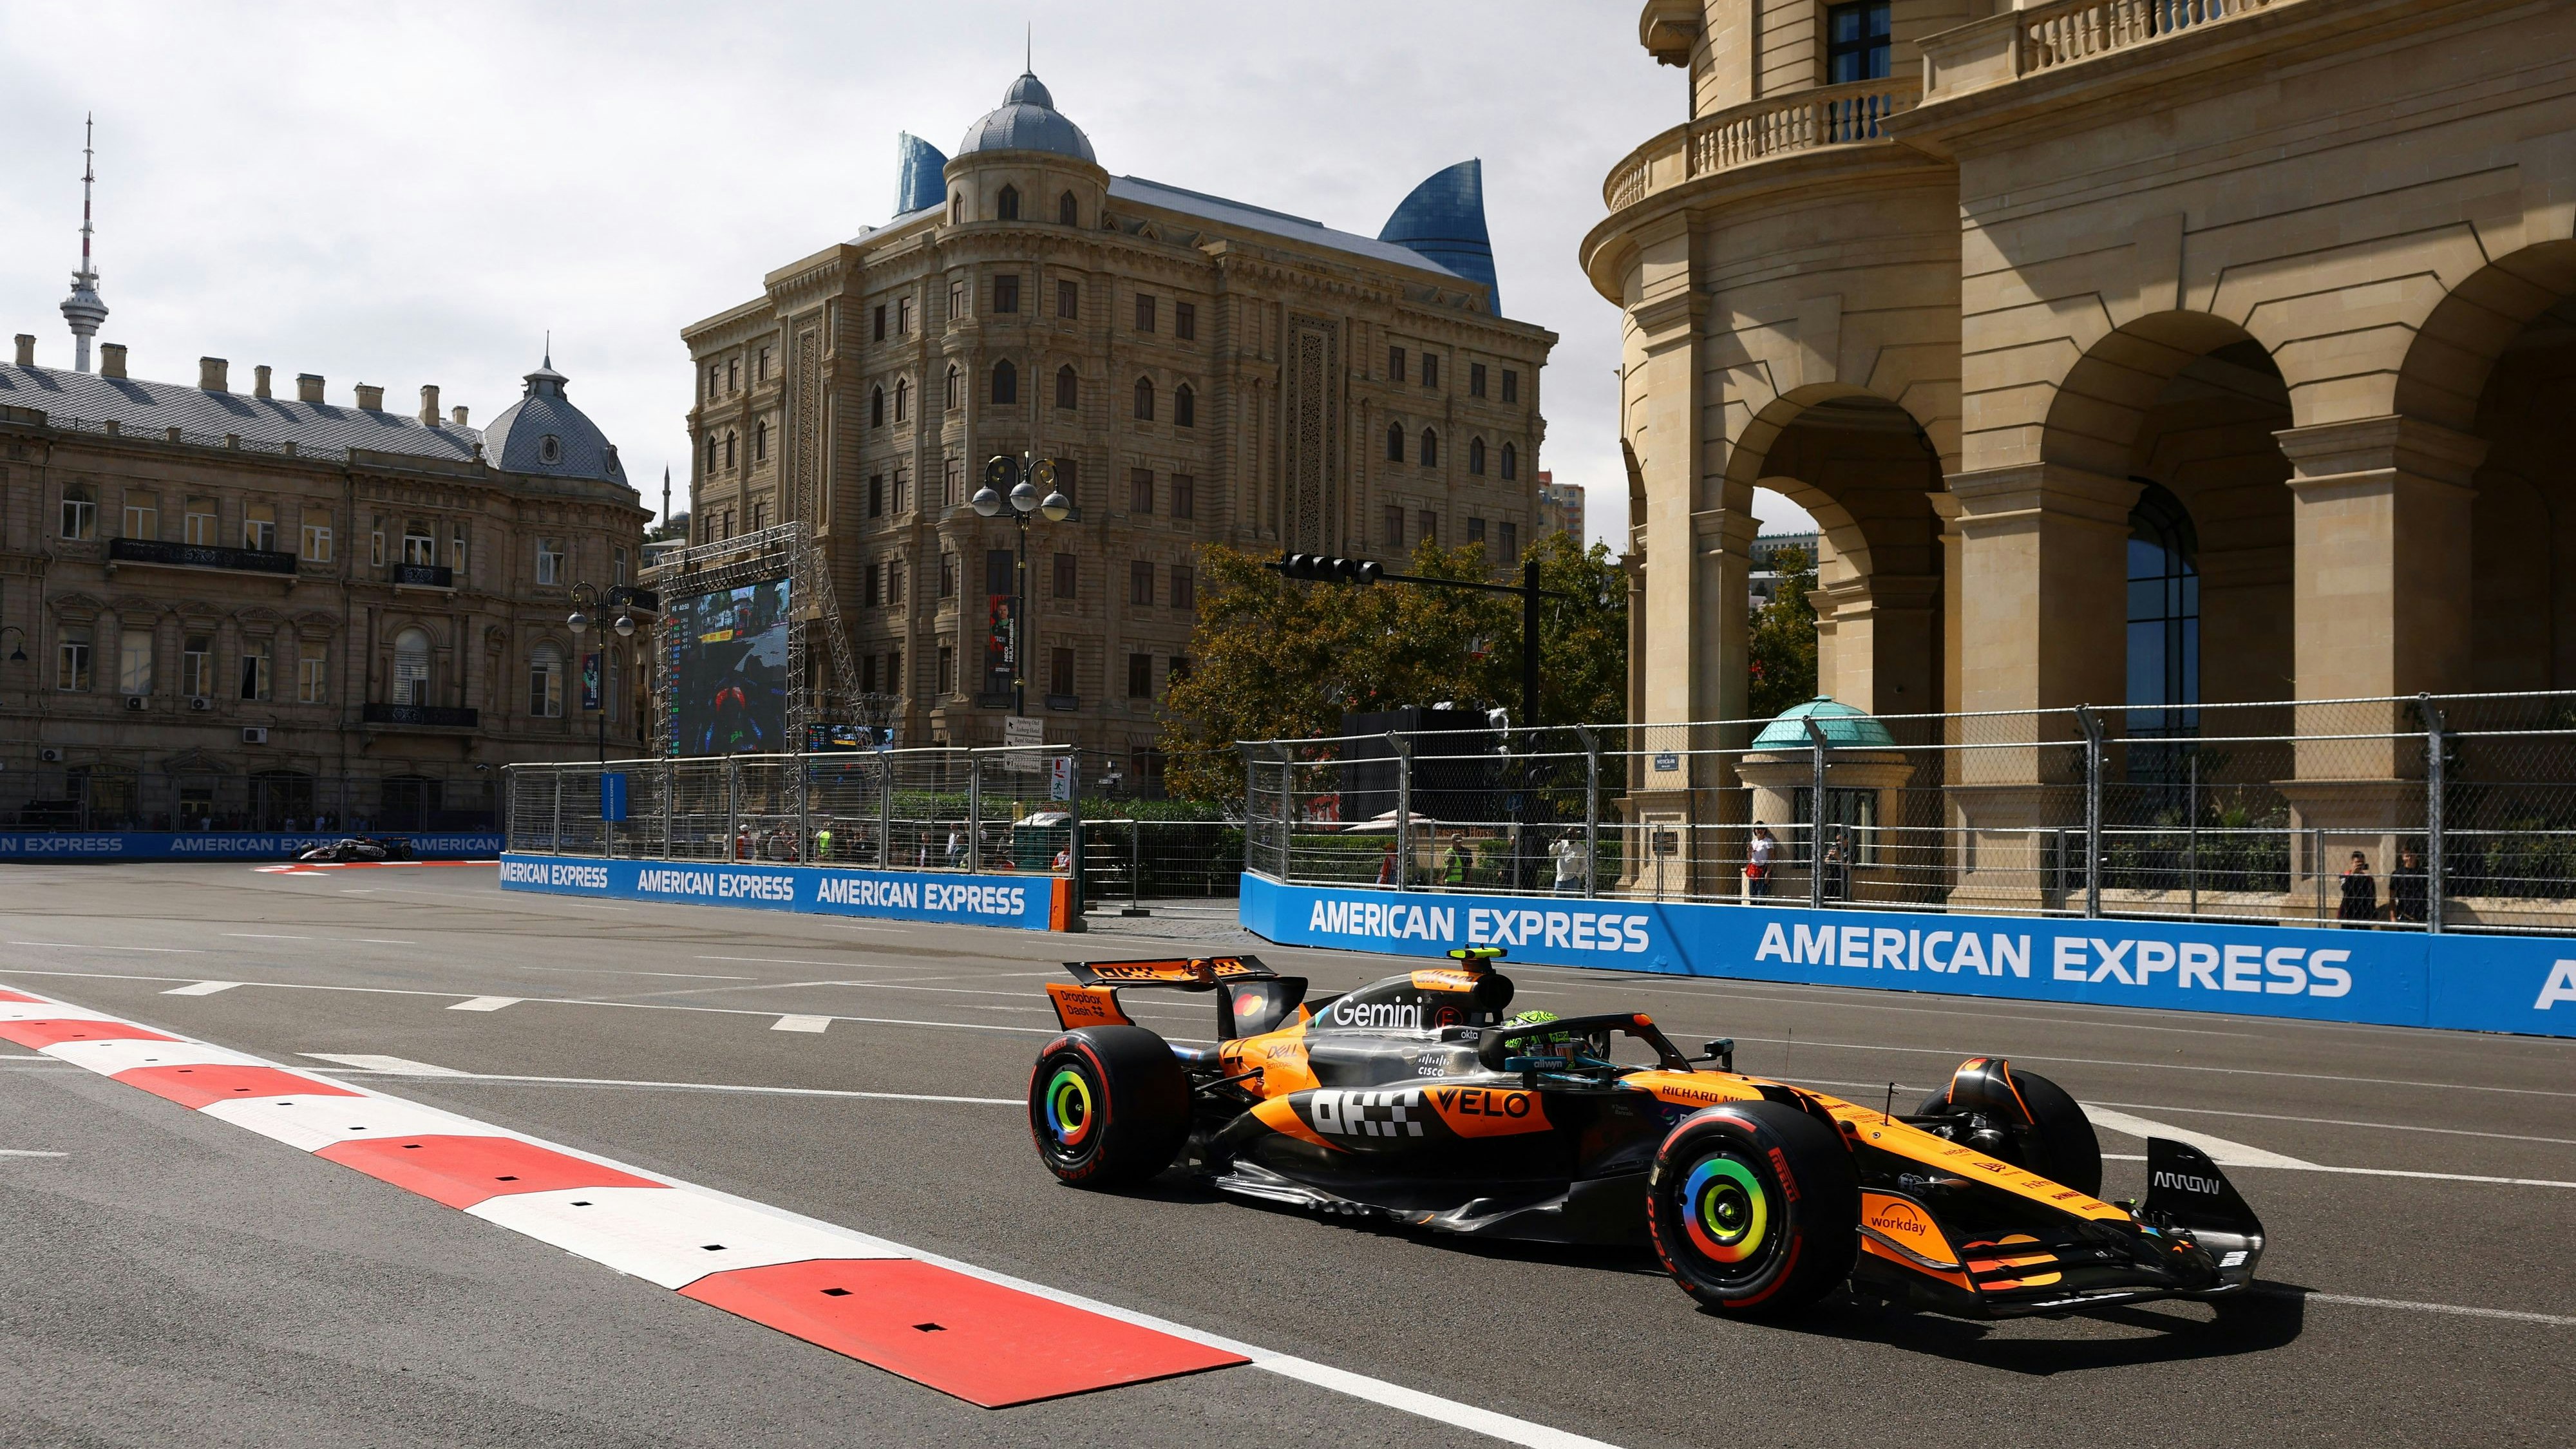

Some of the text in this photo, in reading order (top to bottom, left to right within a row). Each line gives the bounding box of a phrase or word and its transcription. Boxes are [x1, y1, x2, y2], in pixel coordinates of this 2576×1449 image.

[25, 838, 122, 851] EXPRESS
[170, 838, 273, 851] AMERICAN
[411, 838, 498, 850] AMERICAN
[500, 862, 607, 887] MERICAN EXPRESS
[638, 870, 793, 900] AMERICAN EXPRESS
[817, 878, 1024, 914] AMERICAN EXPRESS
[1309, 900, 1649, 952] AMERICAN EXPRESS
[1755, 923, 2351, 997] AMERICAN EXPRESS
[1060, 990, 1103, 1005] Dropbox
[1066, 1005, 1094, 1016] Dash
[1334, 996, 1422, 1028] Gemini
[1461, 1030, 1479, 1039] okta
[1043, 1037, 1067, 1057] PIRELLI
[1267, 1043, 1297, 1059] DELL
[1533, 1059, 1563, 1069] allwyn
[1437, 1088, 1531, 1119] VELO
[1662, 1085, 1718, 1103] RICHARD
[1768, 1147, 1802, 1203] PIRELLI
[2020, 1180, 2055, 1189] FxPro
[2154, 1171, 2220, 1195] ARROW
[1871, 1217, 1926, 1236] workday
